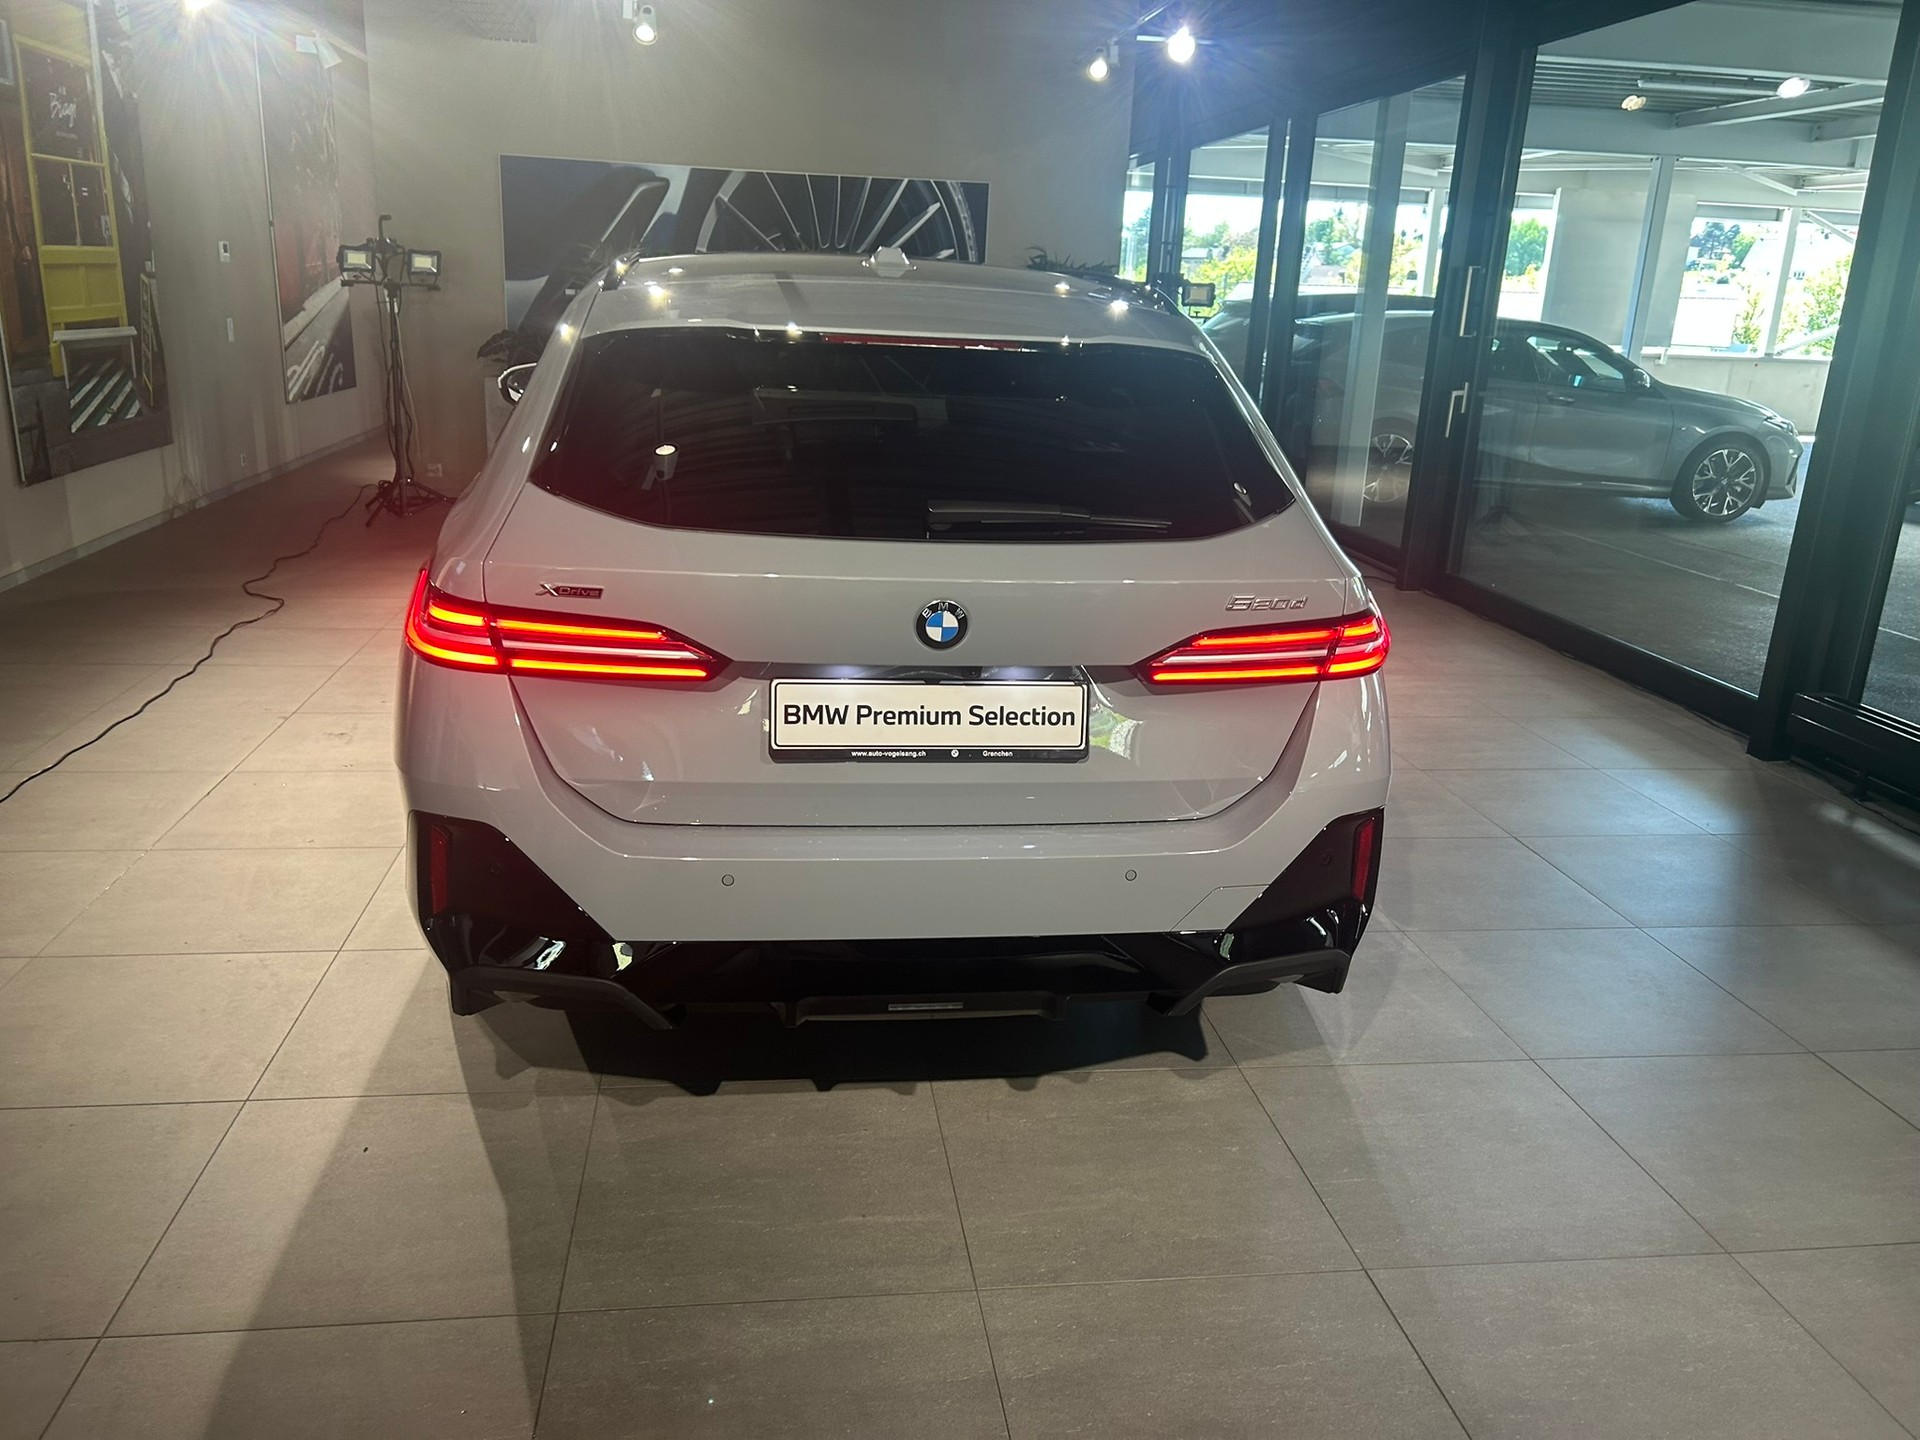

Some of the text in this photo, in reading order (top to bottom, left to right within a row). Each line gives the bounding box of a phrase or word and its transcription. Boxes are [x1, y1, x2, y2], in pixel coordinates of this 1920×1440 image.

[921, 602, 965, 620] BMW
[1225, 595, 1308, 611] 520d
[783, 704, 1075, 726] BMW Premium Selection
[851, 750, 927, 758] www.auto-vogelsang.ch
